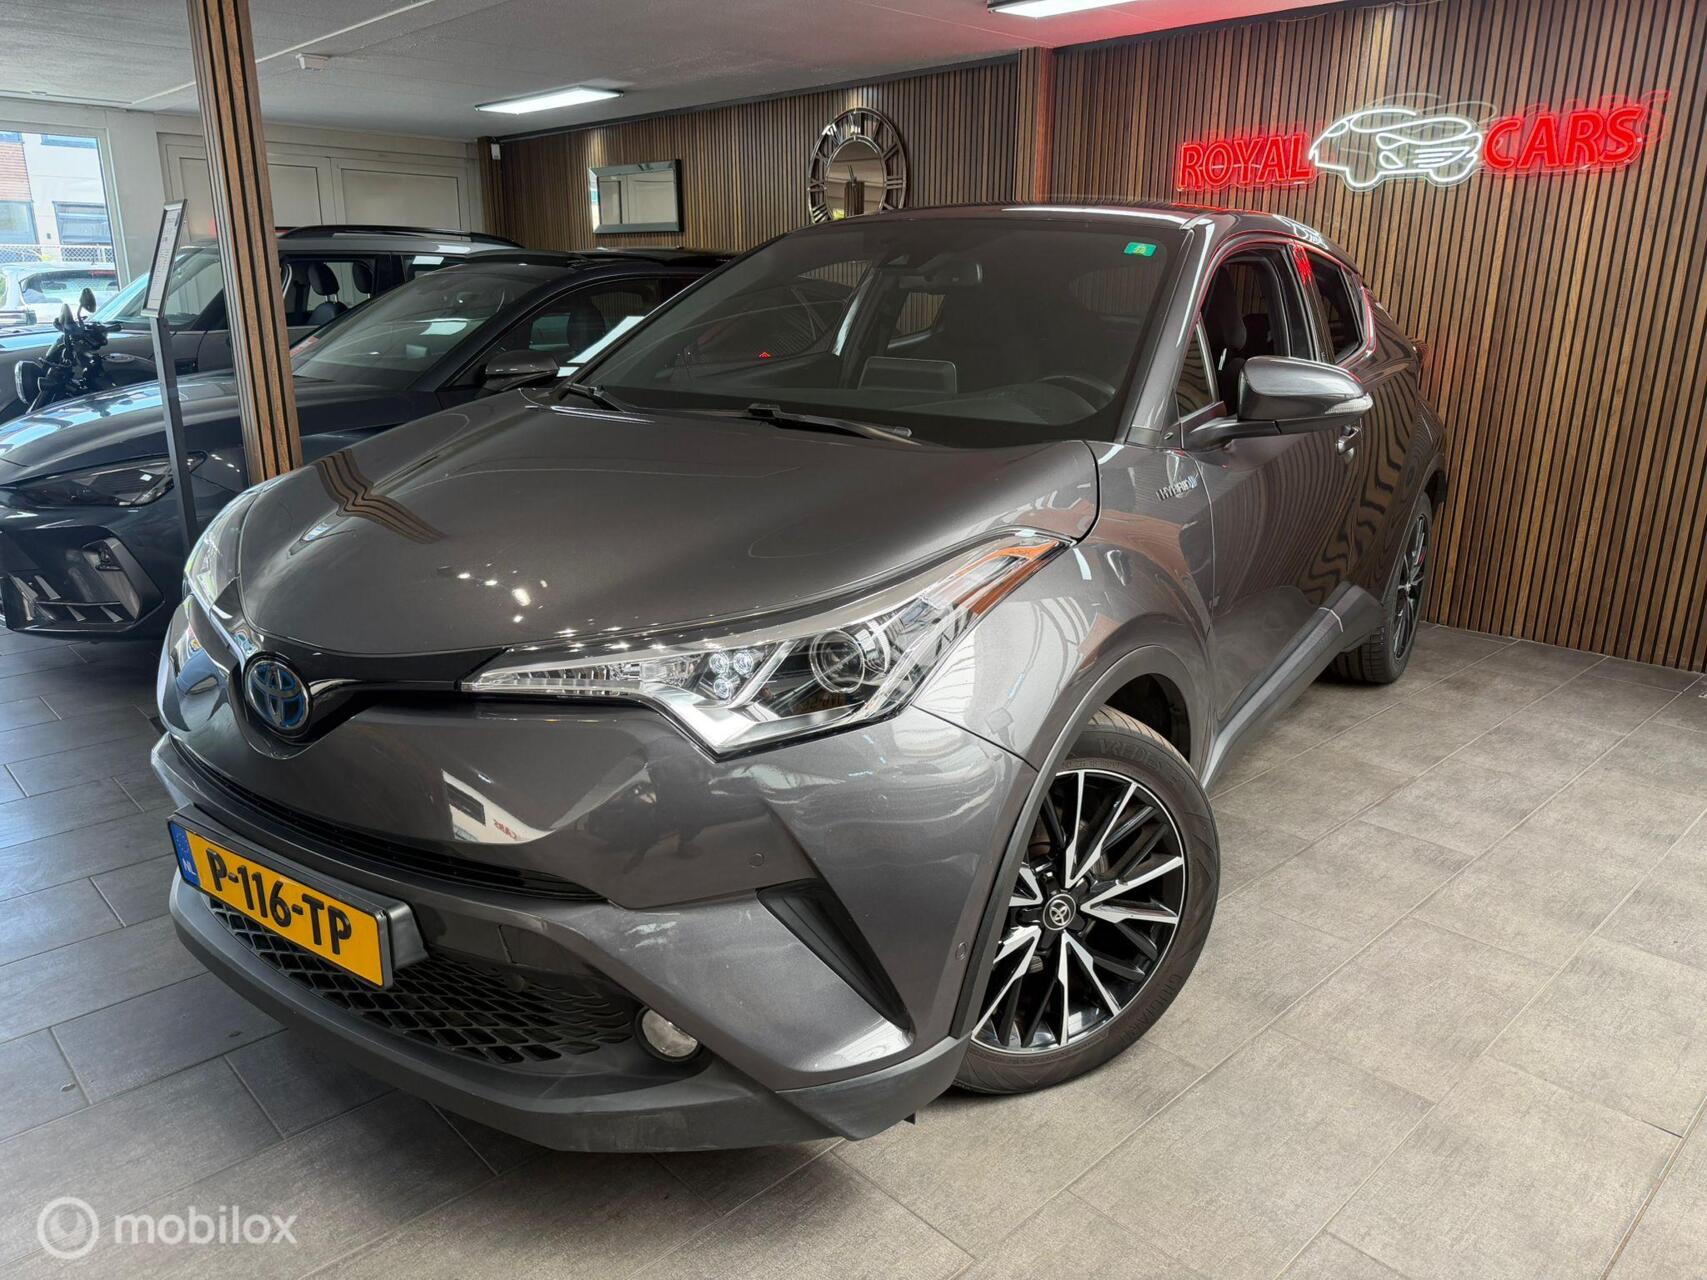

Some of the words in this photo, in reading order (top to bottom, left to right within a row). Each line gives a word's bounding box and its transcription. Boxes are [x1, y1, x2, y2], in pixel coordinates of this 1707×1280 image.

[1178, 134, 1314, 189] ROYAL
[1483, 105, 1645, 171] CARS
[1155, 478, 1192, 501] HYBRID
[182, 858, 197, 876] NL
[205, 847, 353, 956] P-116-TP
